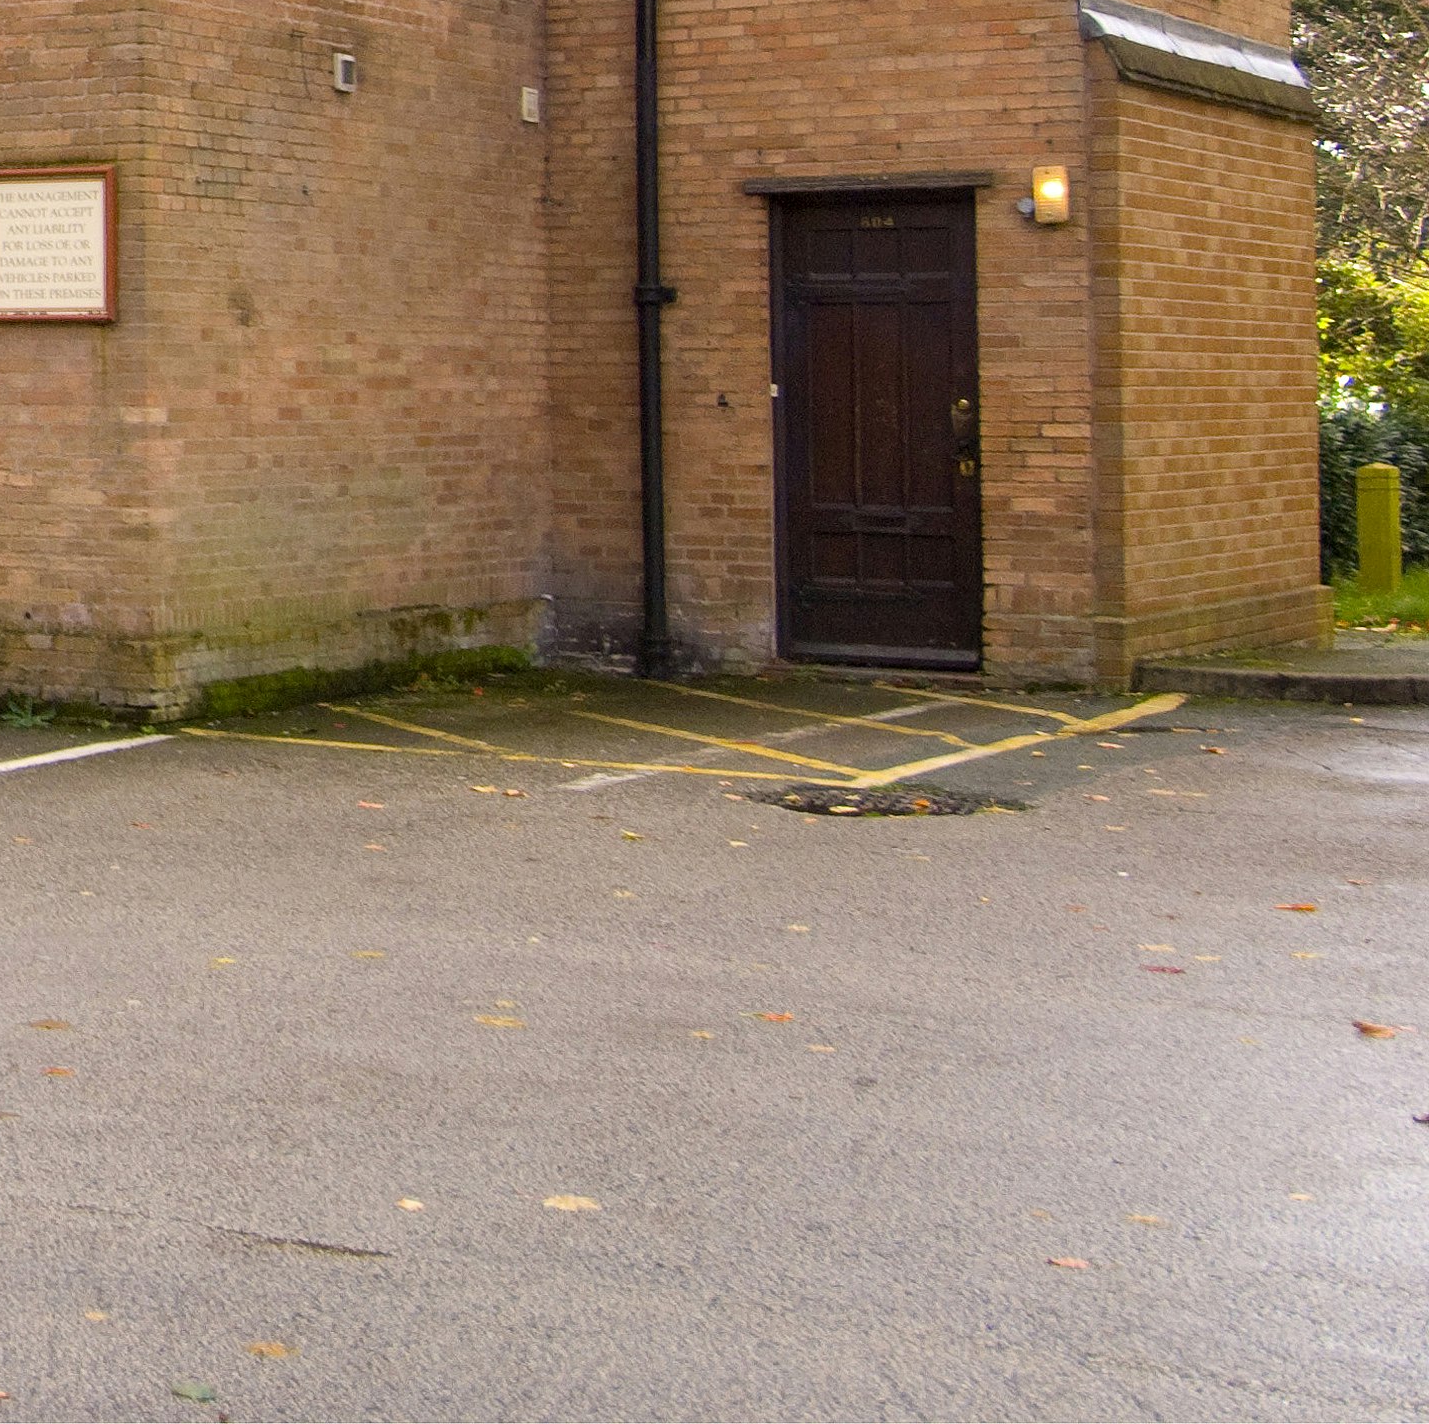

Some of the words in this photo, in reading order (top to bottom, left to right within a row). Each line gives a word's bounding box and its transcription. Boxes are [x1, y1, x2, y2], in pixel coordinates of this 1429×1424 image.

[17, 190, 99, 202] MANAGEMENT
[50, 207, 94, 217] ACCEPT
[7, 225, 30, 235] ANY
[33, 224, 86, 234] LIABILITY
[2, 241, 23, 251] FOR
[26, 241, 53, 251] LOSS
[73, 240, 91, 250] OR
[0, 257, 48, 267] DAMAGE
[51, 256, 67, 266] TO
[71, 256, 93, 266] ANY
[53, 272, 96, 283] PARKED
[13, 289, 47, 299] THESE
[49, 289, 101, 299] PREMISES
